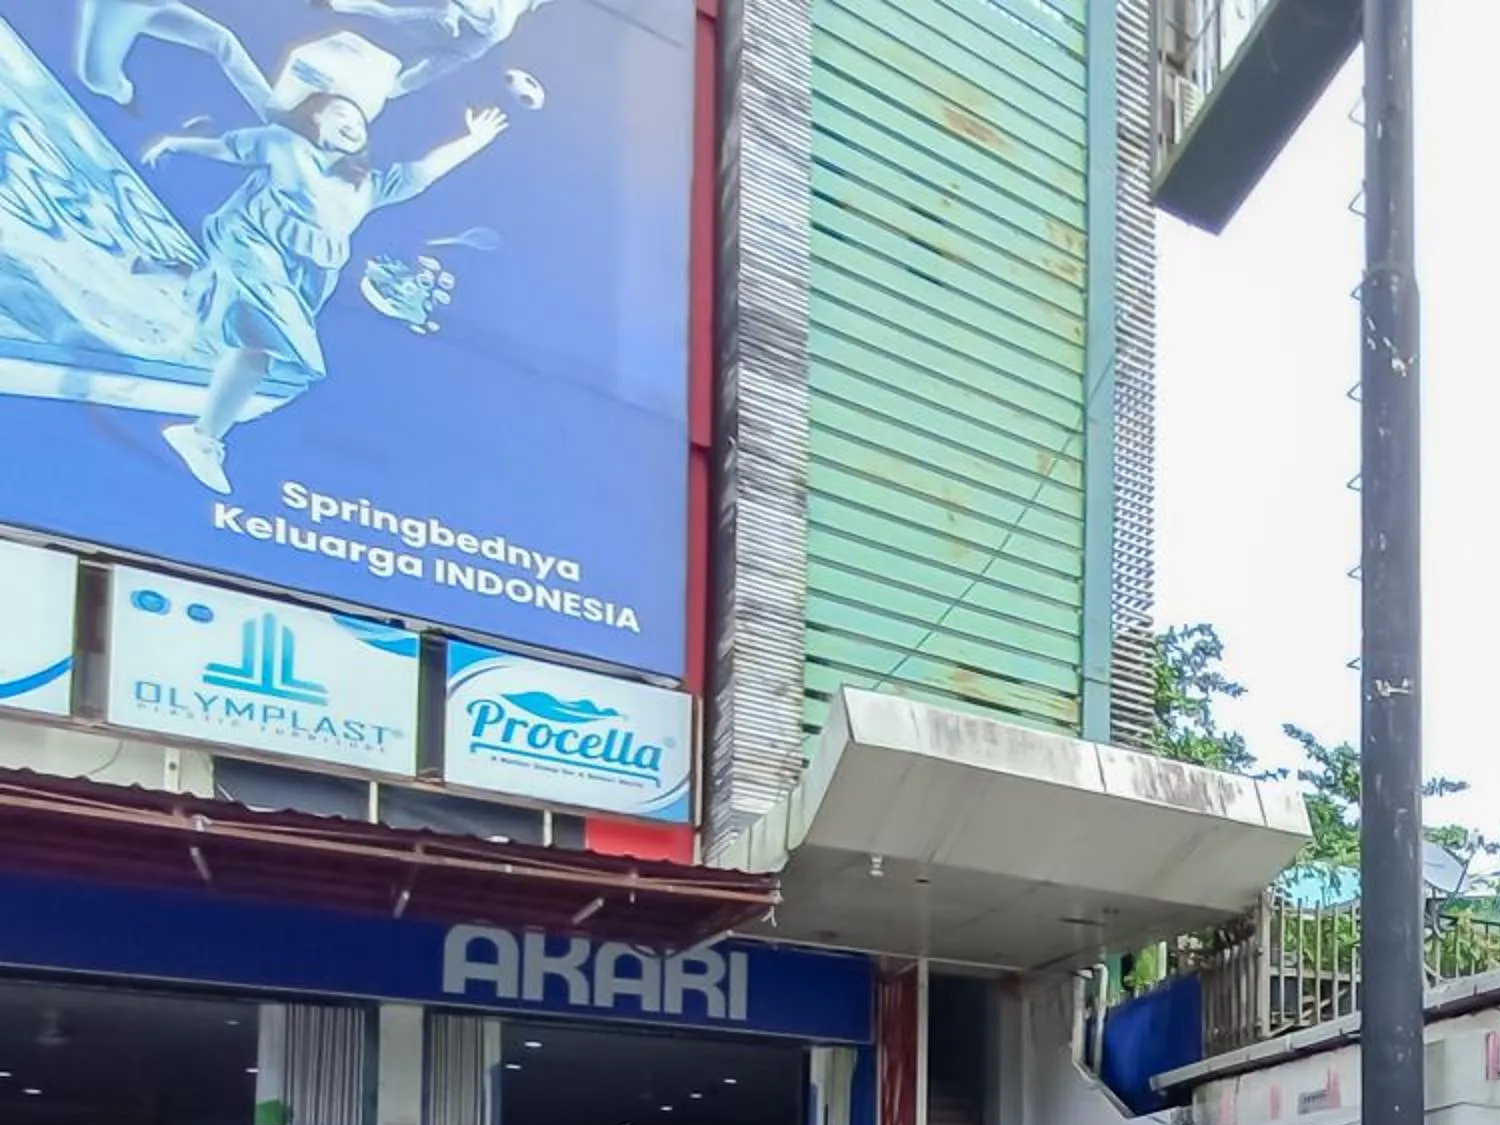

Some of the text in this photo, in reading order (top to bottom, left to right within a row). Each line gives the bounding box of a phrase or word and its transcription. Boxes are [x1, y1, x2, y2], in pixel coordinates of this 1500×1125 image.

[213, 502, 641, 633] Keluarga INDONESIA
[281, 479, 581, 582] Springbednya
[134, 680, 391, 745] OLYMPLAST
[466, 698, 663, 772] Procella
[442, 923, 748, 1021] AKARI
